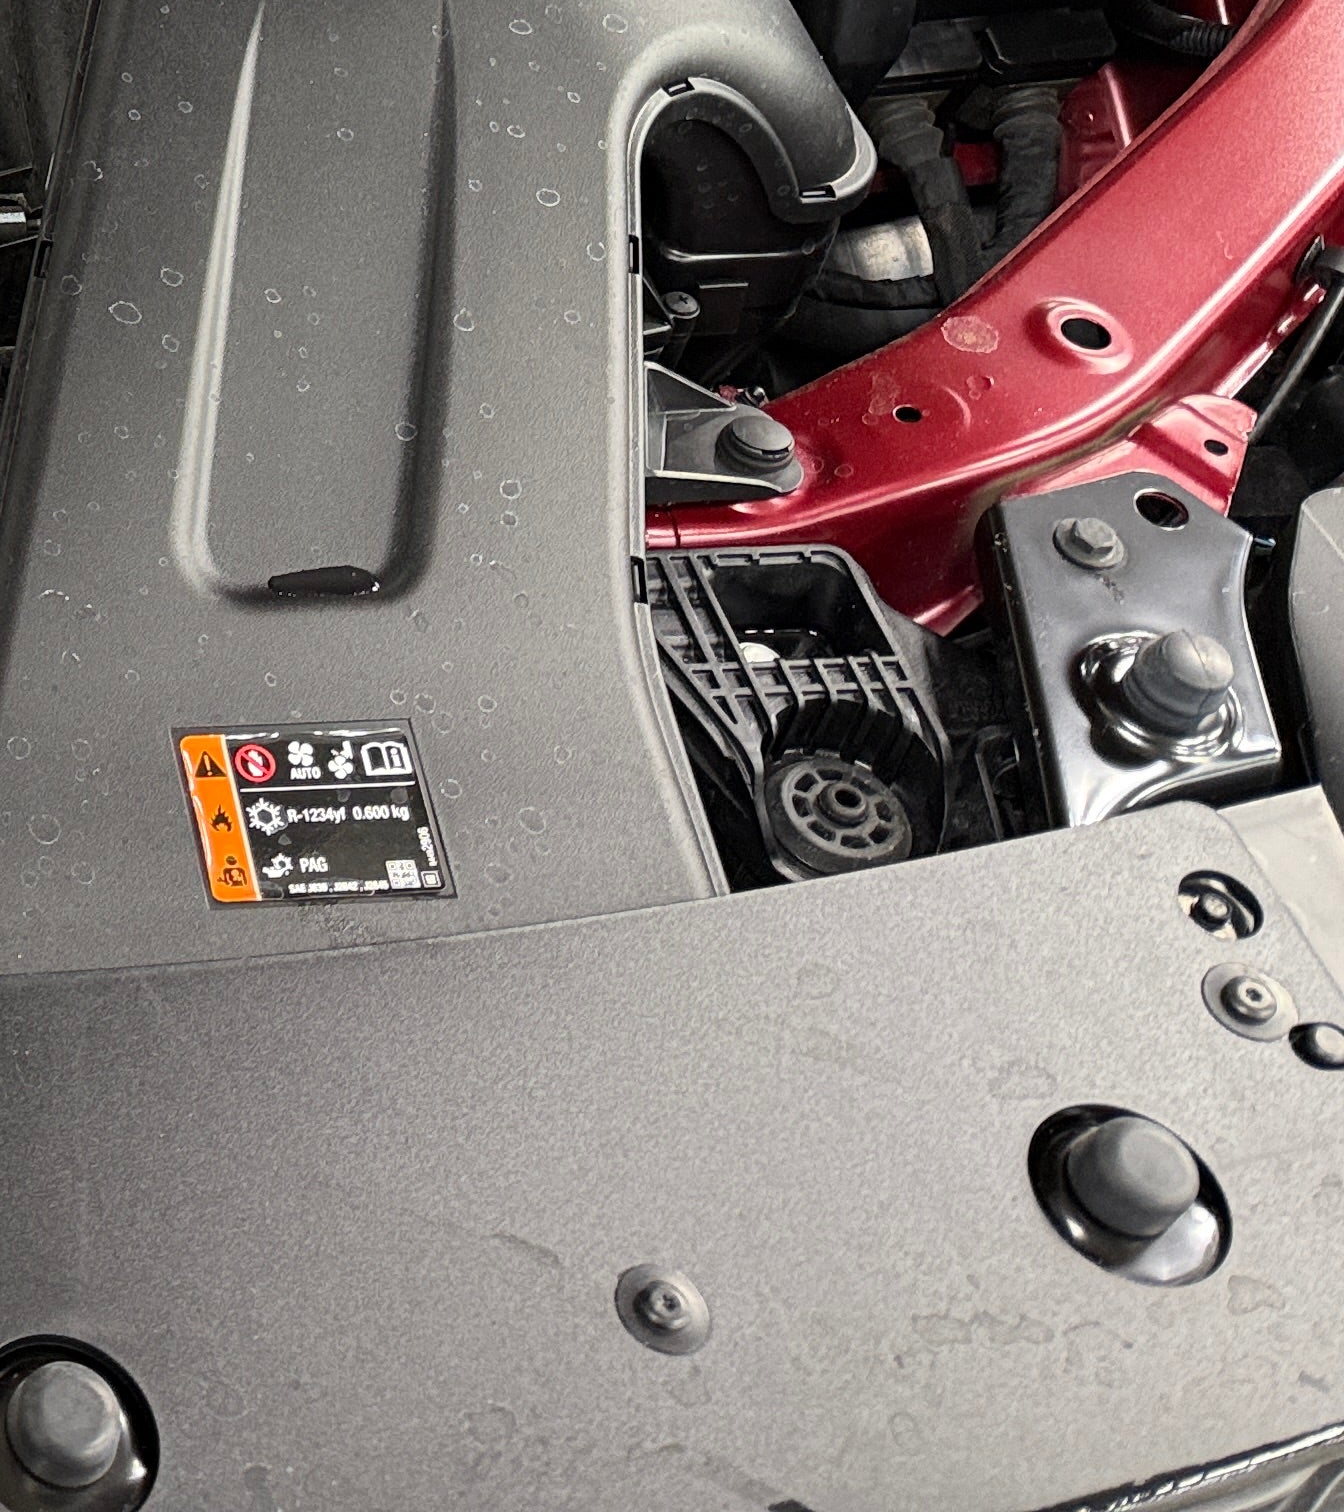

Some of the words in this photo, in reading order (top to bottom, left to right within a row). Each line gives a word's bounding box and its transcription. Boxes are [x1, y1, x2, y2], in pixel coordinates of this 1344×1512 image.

[289, 767, 322, 780] AUTO
[286, 806, 347, 824] R-1234yf
[352, 805, 390, 820] 0.600
[391, 804, 410, 821] kg
[299, 857, 329, 873] PAG
